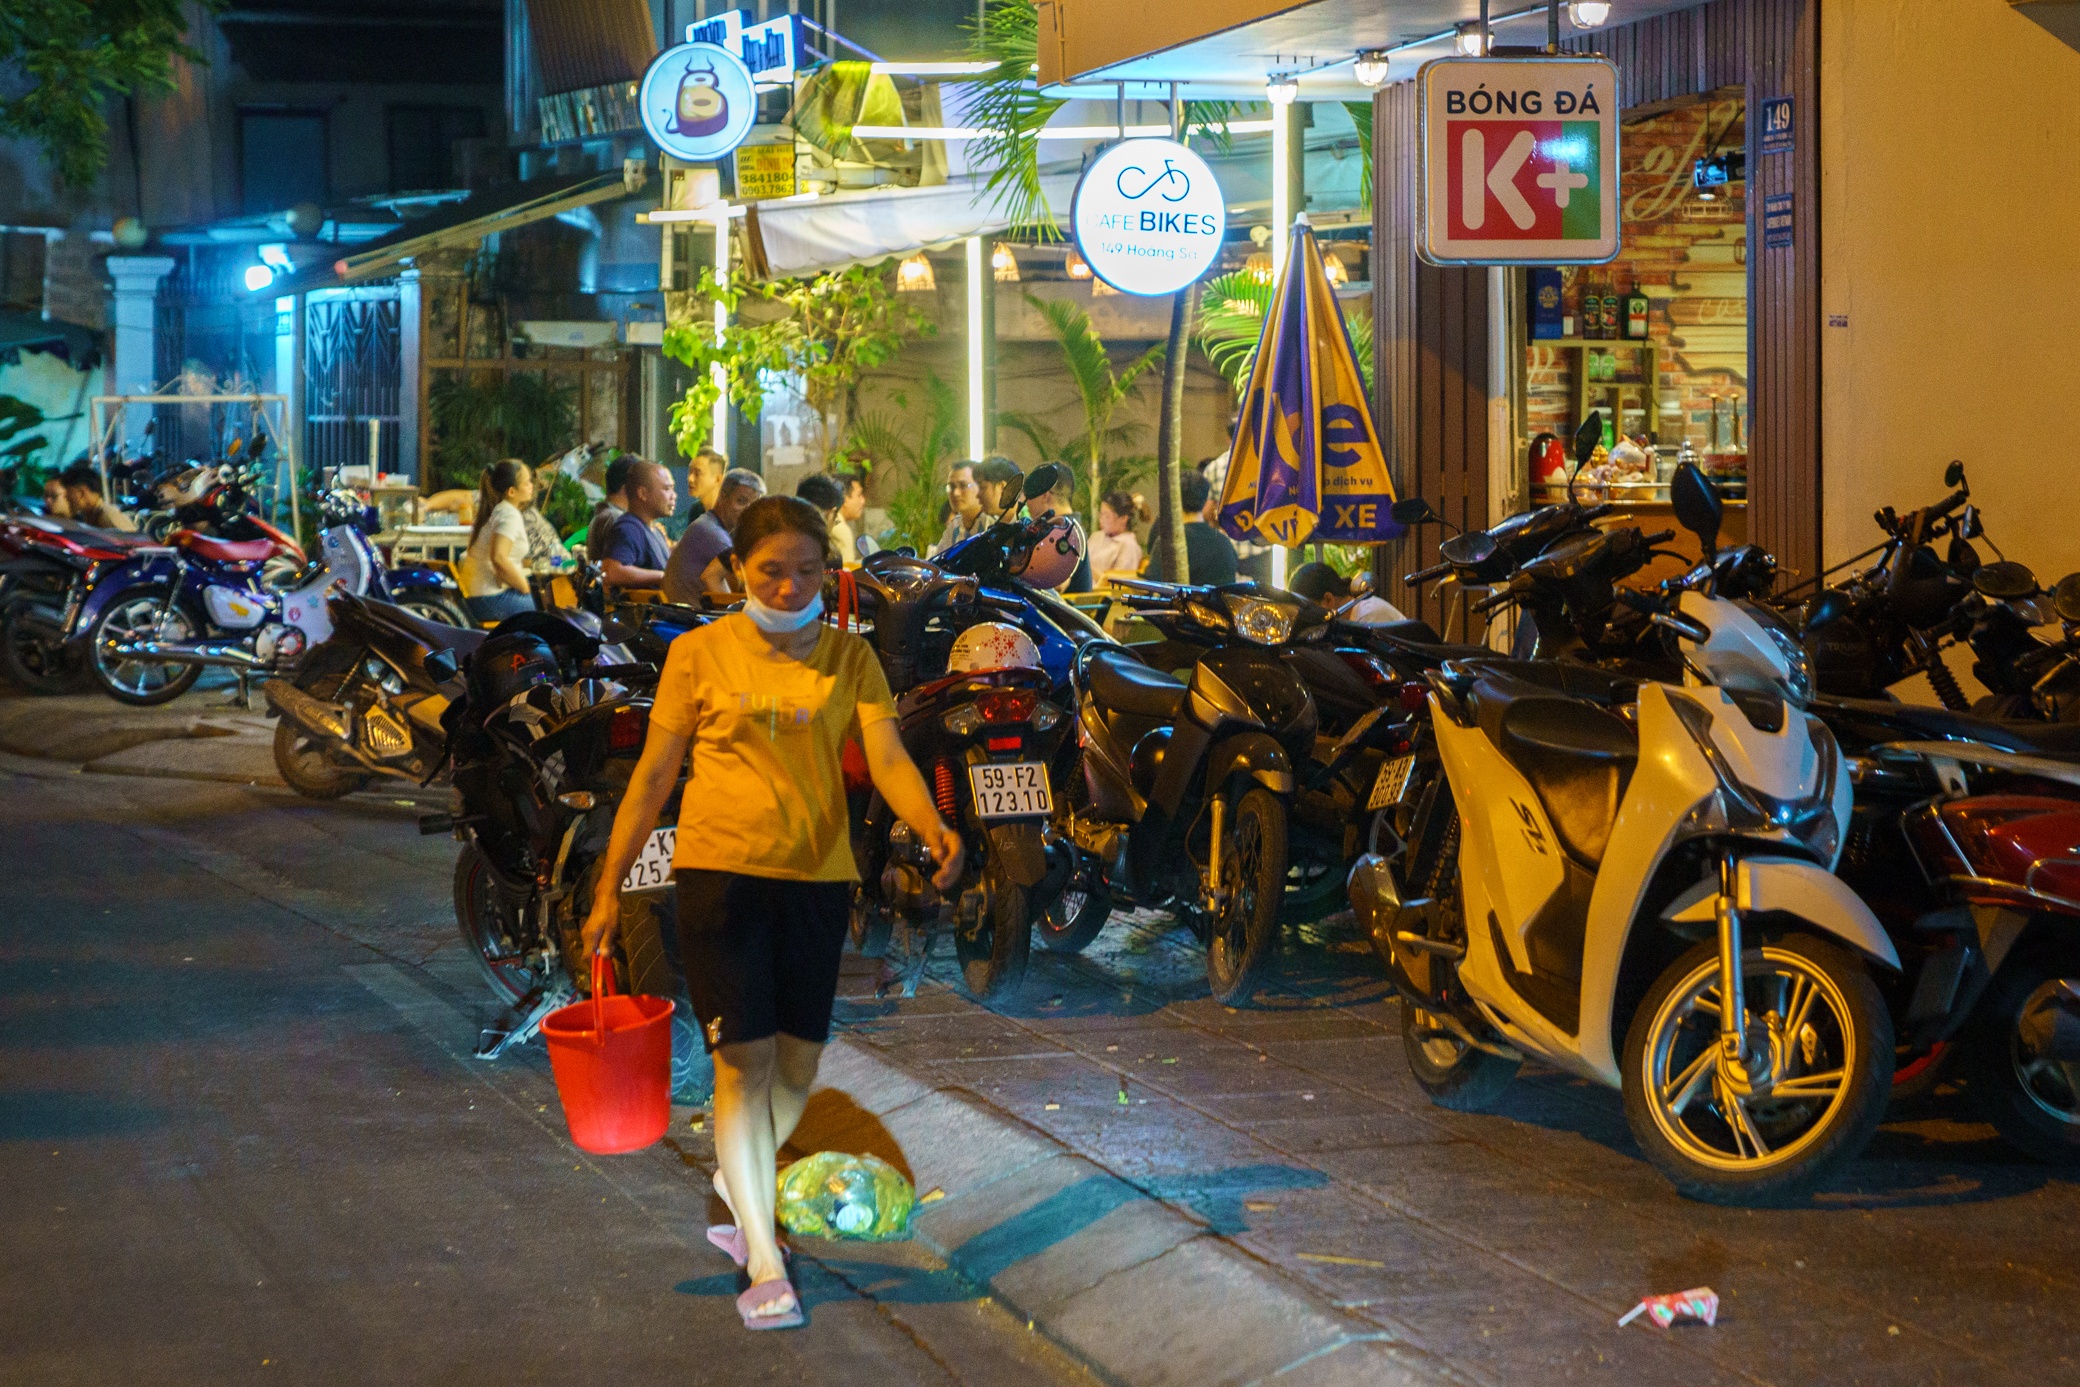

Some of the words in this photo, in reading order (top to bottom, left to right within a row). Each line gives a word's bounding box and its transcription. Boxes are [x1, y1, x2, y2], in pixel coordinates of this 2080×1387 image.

[1447, 83, 1543, 115] BÓNG
[1554, 83, 1601, 115] ĐÁ
[1765, 102, 1791, 132] 149
[1462, 128, 1589, 231] K+
[1086, 213, 1135, 232] AFE
[1139, 210, 1217, 236] BIKES
[1101, 242, 1124, 254] 149
[982, 766, 1038, 789] 59-F2
[979, 790, 1048, 813] 123.10
[622, 856, 673, 889] 25
